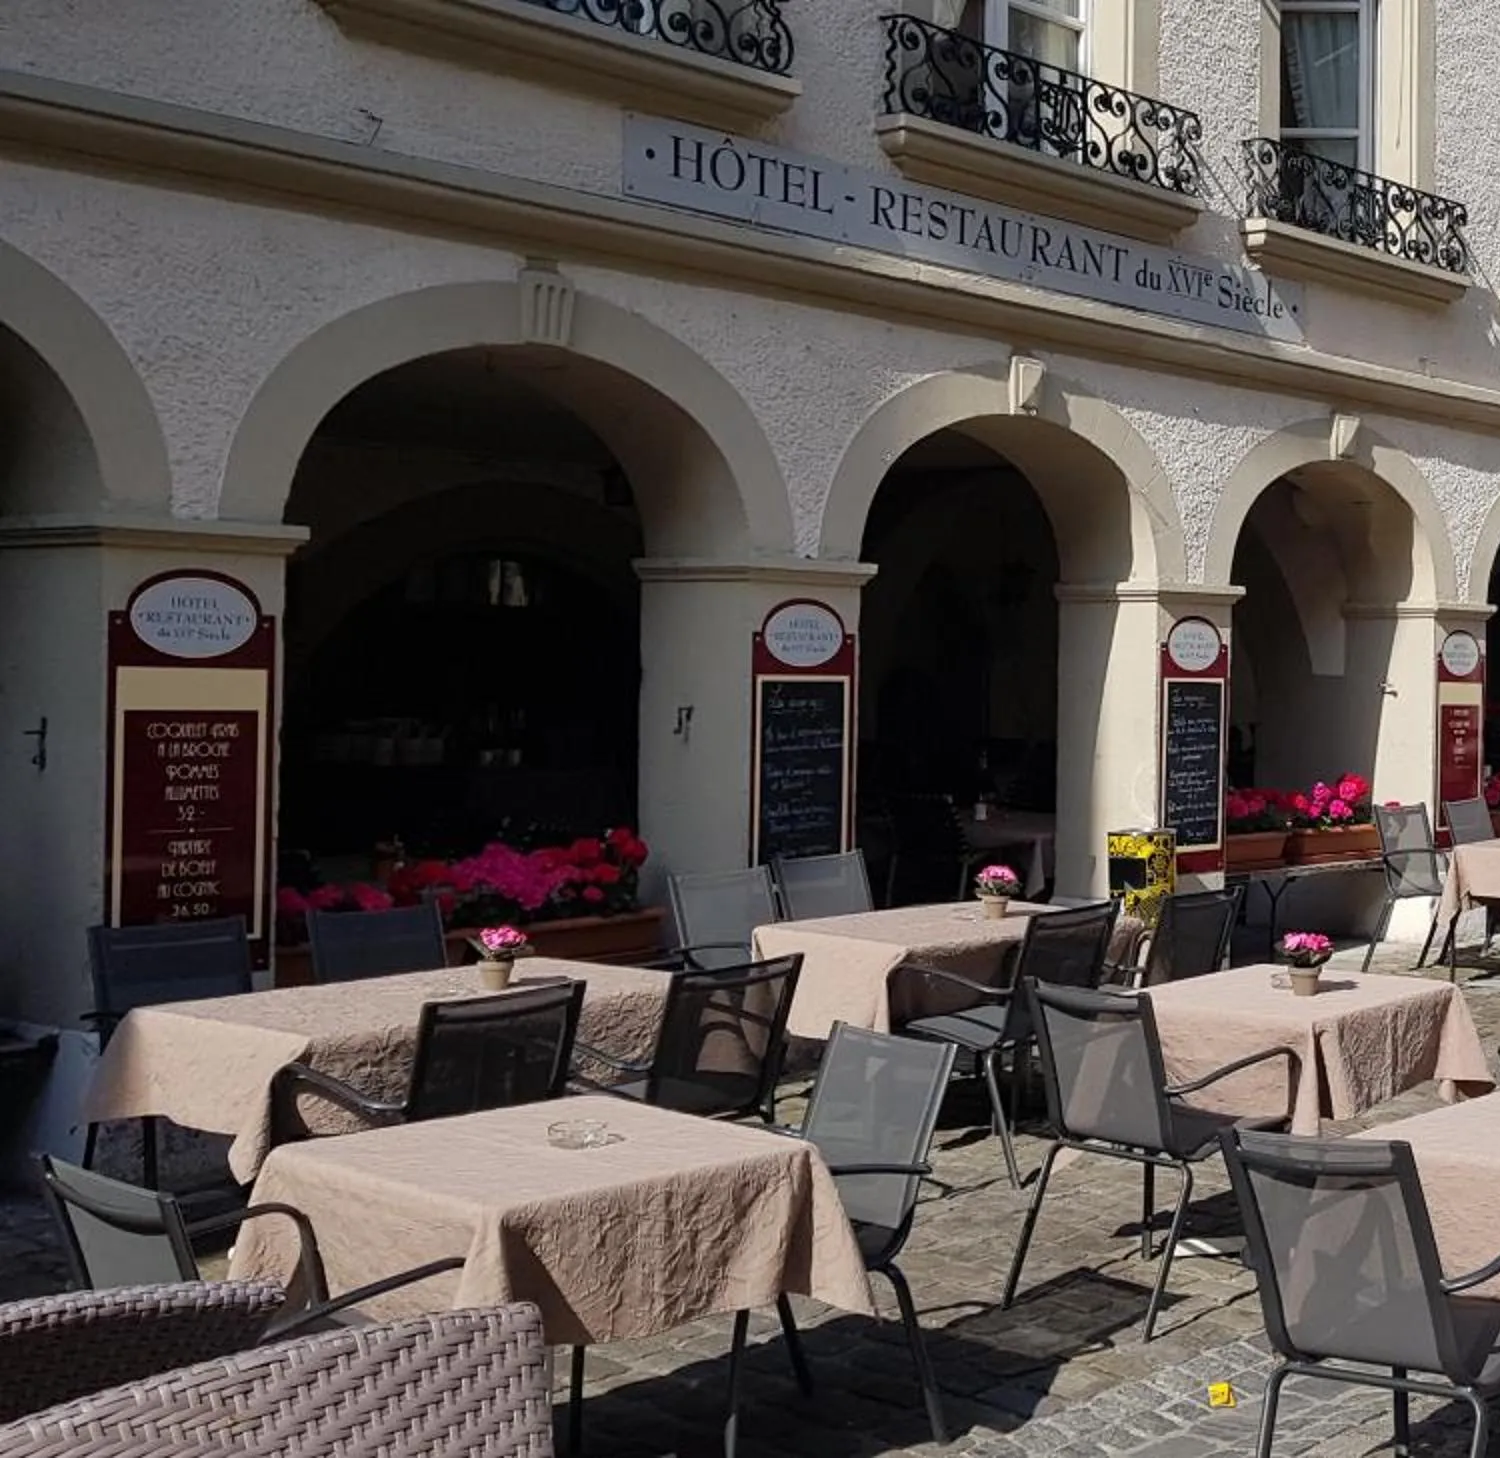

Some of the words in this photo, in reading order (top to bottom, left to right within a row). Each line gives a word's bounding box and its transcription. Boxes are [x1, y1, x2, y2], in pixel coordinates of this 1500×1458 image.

[668, 135, 833, 214] HÔTEL
[870, 186, 1129, 282] RESTAURANT
[1135, 258, 1161, 290] du
[1217, 275, 1283, 319] Siècle
[146, 611, 245, 626] RESTAURANT
[166, 764, 220, 781] POMMES
